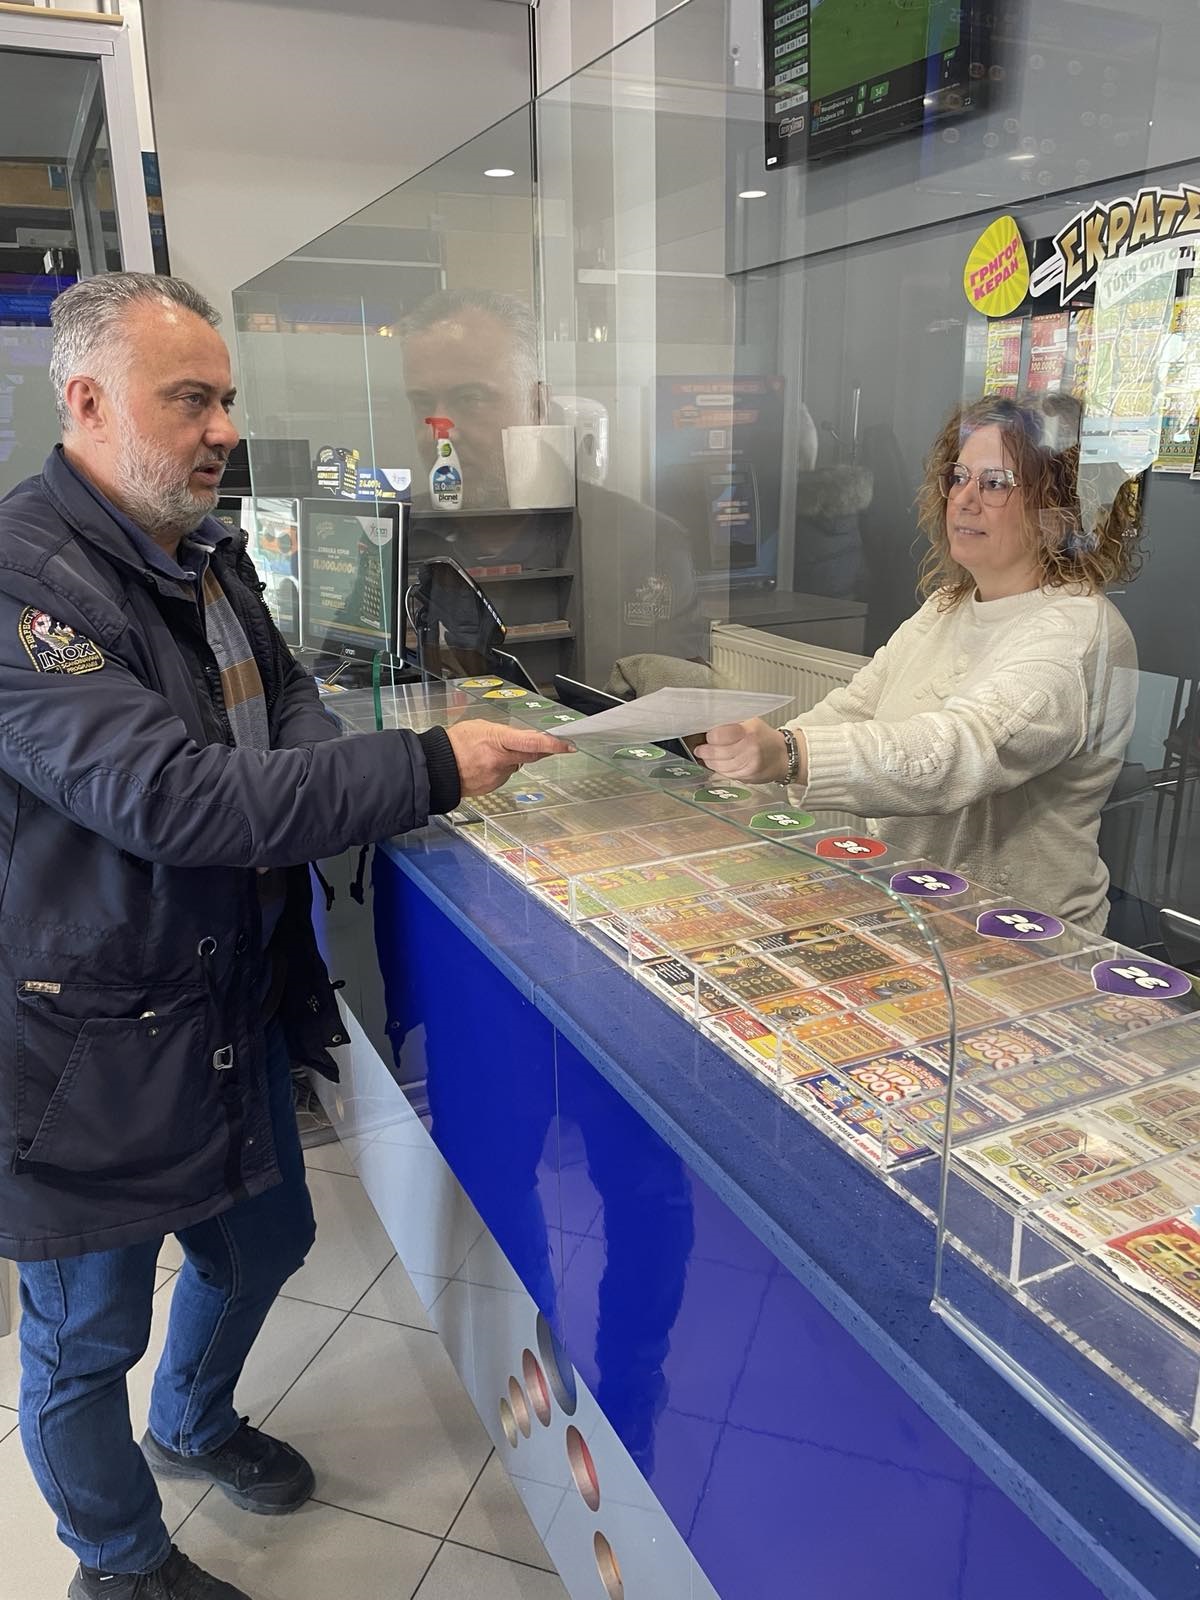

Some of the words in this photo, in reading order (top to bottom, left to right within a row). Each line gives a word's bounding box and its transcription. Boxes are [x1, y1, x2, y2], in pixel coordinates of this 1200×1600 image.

[969, 233, 1020, 286] ΓΡΗΓΟΡ
[38, 643, 96, 669] INOX
[766, 814, 800, 827] 5€
[833, 839, 872, 855] 3€
[907, 874, 951, 892] 2€
[995, 912, 1045, 934] 2€
[1109, 965, 1171, 991] 2€
[1152, 1286, 1188, 1311] ΚΕΡΔΙΣΤΕ
